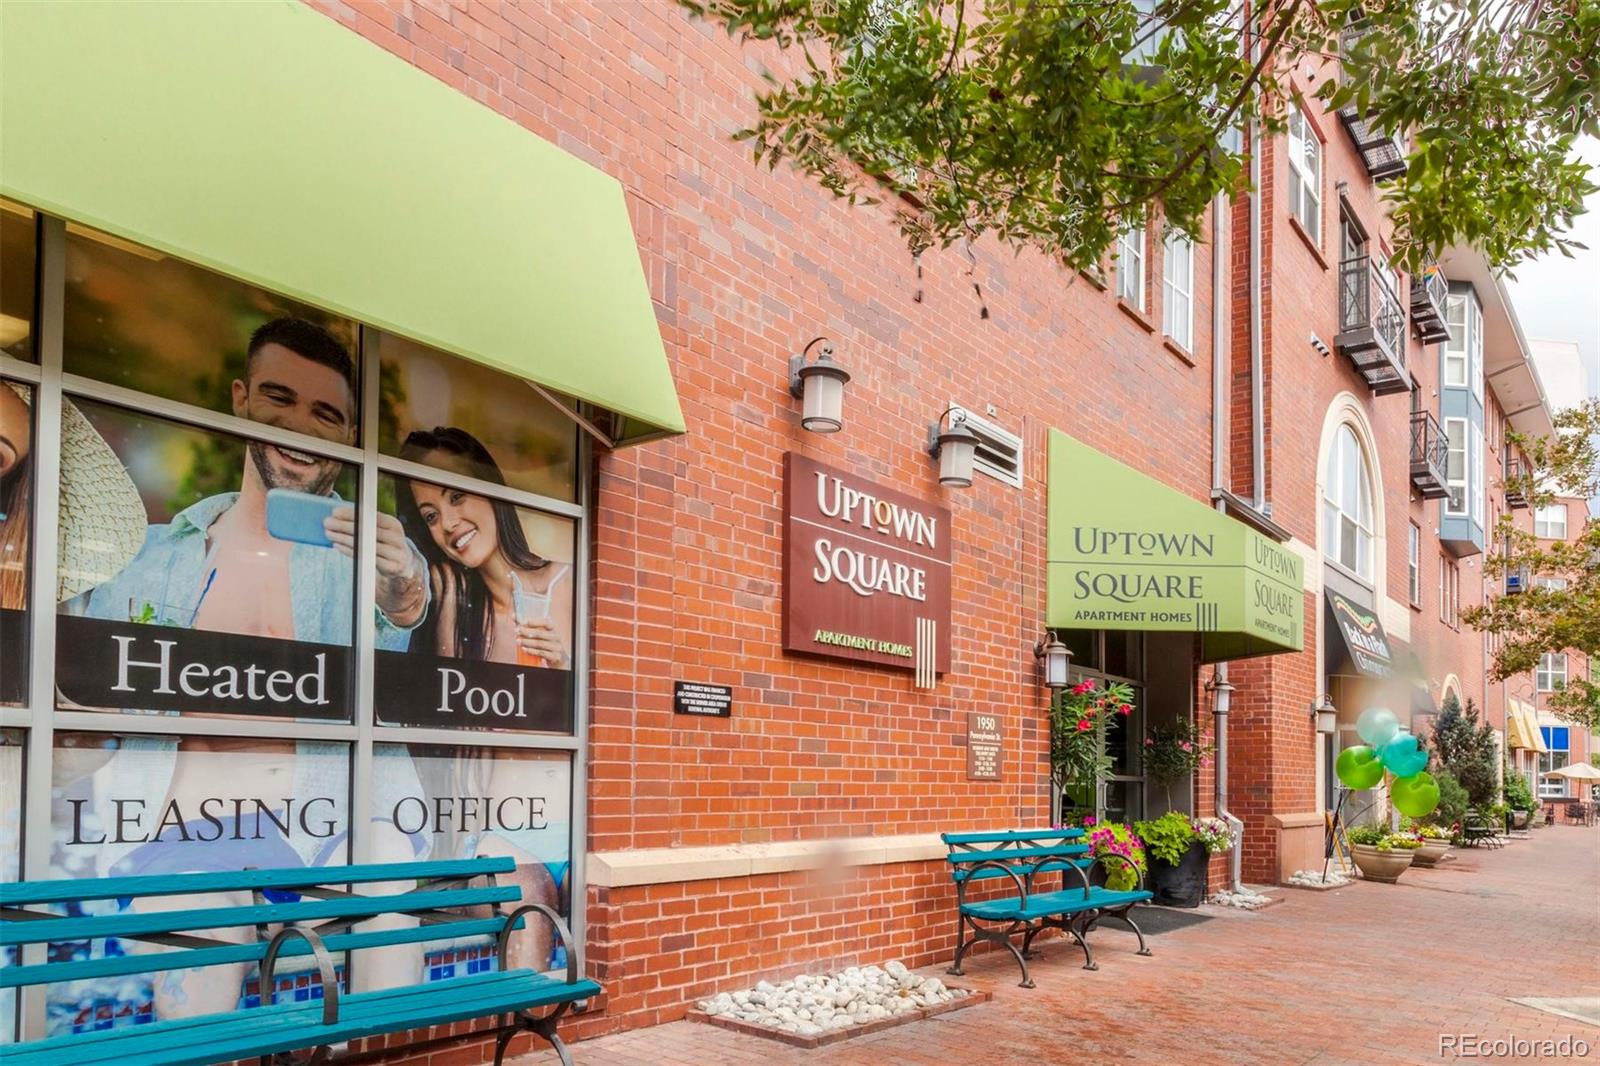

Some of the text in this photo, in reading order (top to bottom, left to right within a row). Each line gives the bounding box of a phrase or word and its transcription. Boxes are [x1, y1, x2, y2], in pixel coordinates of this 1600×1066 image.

[814, 471, 937, 549] UPTOWN
[1073, 527, 1214, 557] UPTOWN
[1255, 535, 1296, 580] UPTOWN
[813, 538, 926, 602] SQUARE
[1073, 570, 1203, 603] SQUARE
[1074, 610, 1193, 623] APARTMENT HOMES
[1255, 579, 1293, 618] SQUARE
[814, 629, 913, 658] APARTMENT HOMES
[110, 634, 528, 718] Heated Pool
[976, 716, 996, 731] 1950
[65, 795, 549, 846] LEASING OFFICE
